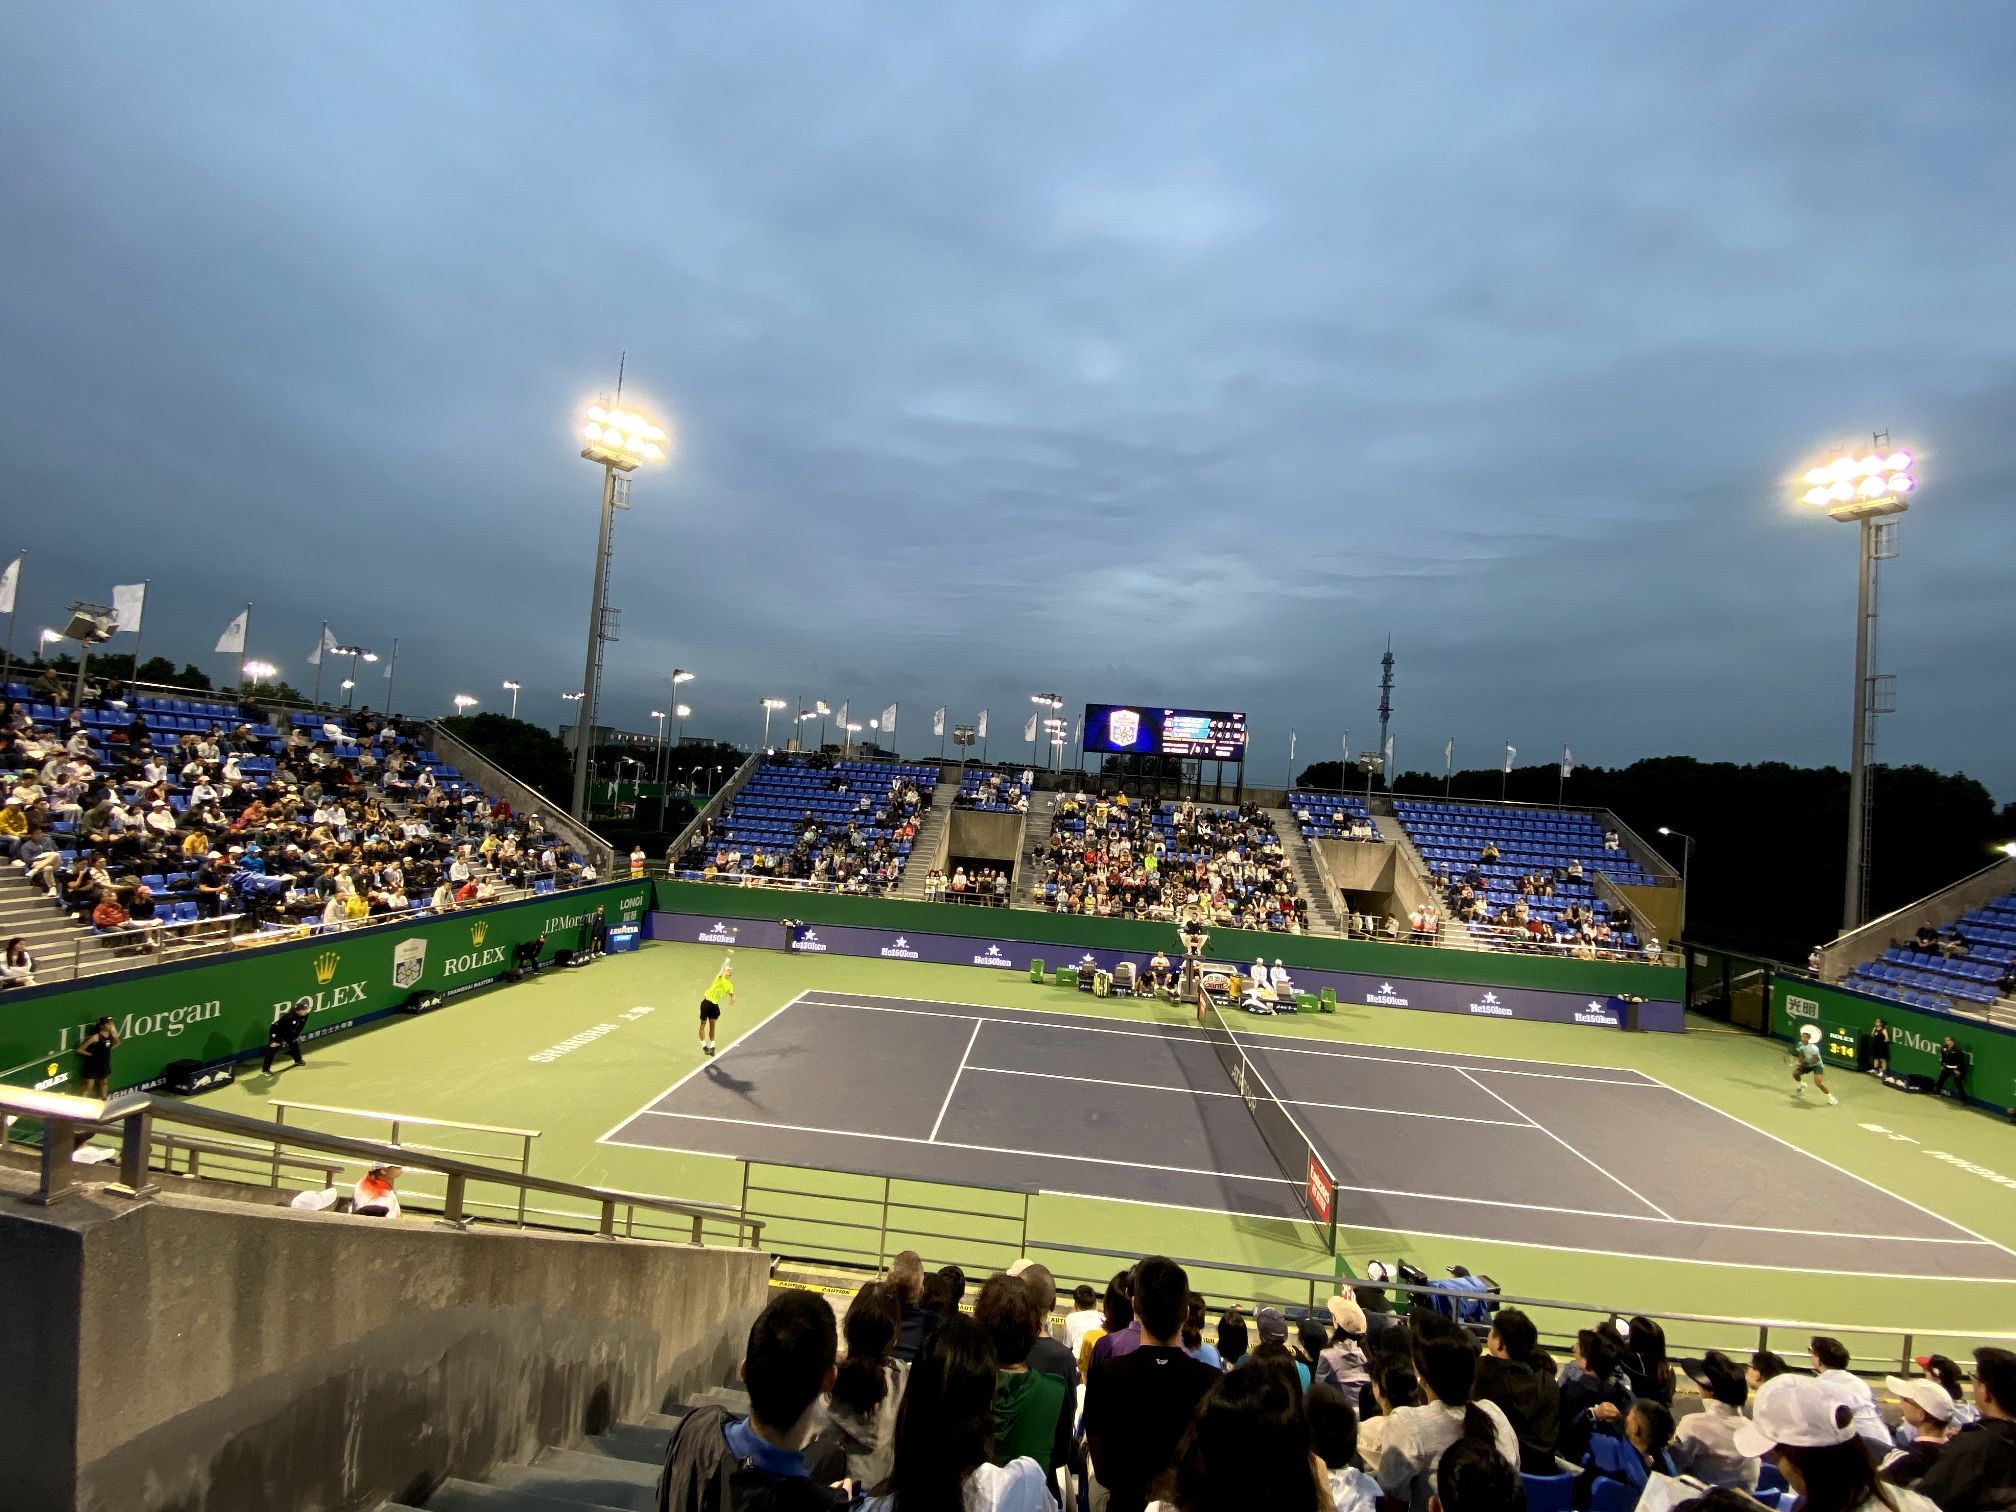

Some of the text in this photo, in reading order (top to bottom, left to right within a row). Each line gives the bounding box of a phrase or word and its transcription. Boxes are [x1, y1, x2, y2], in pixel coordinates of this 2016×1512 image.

[443, 946, 506, 977] ROLEX
[272, 981, 369, 1026] ROLEX
[1788, 998, 1817, 1015] 光明
[527, 1023, 621, 1063] SHANGHAI
[821, 1287, 851, 1296] CAUTION
